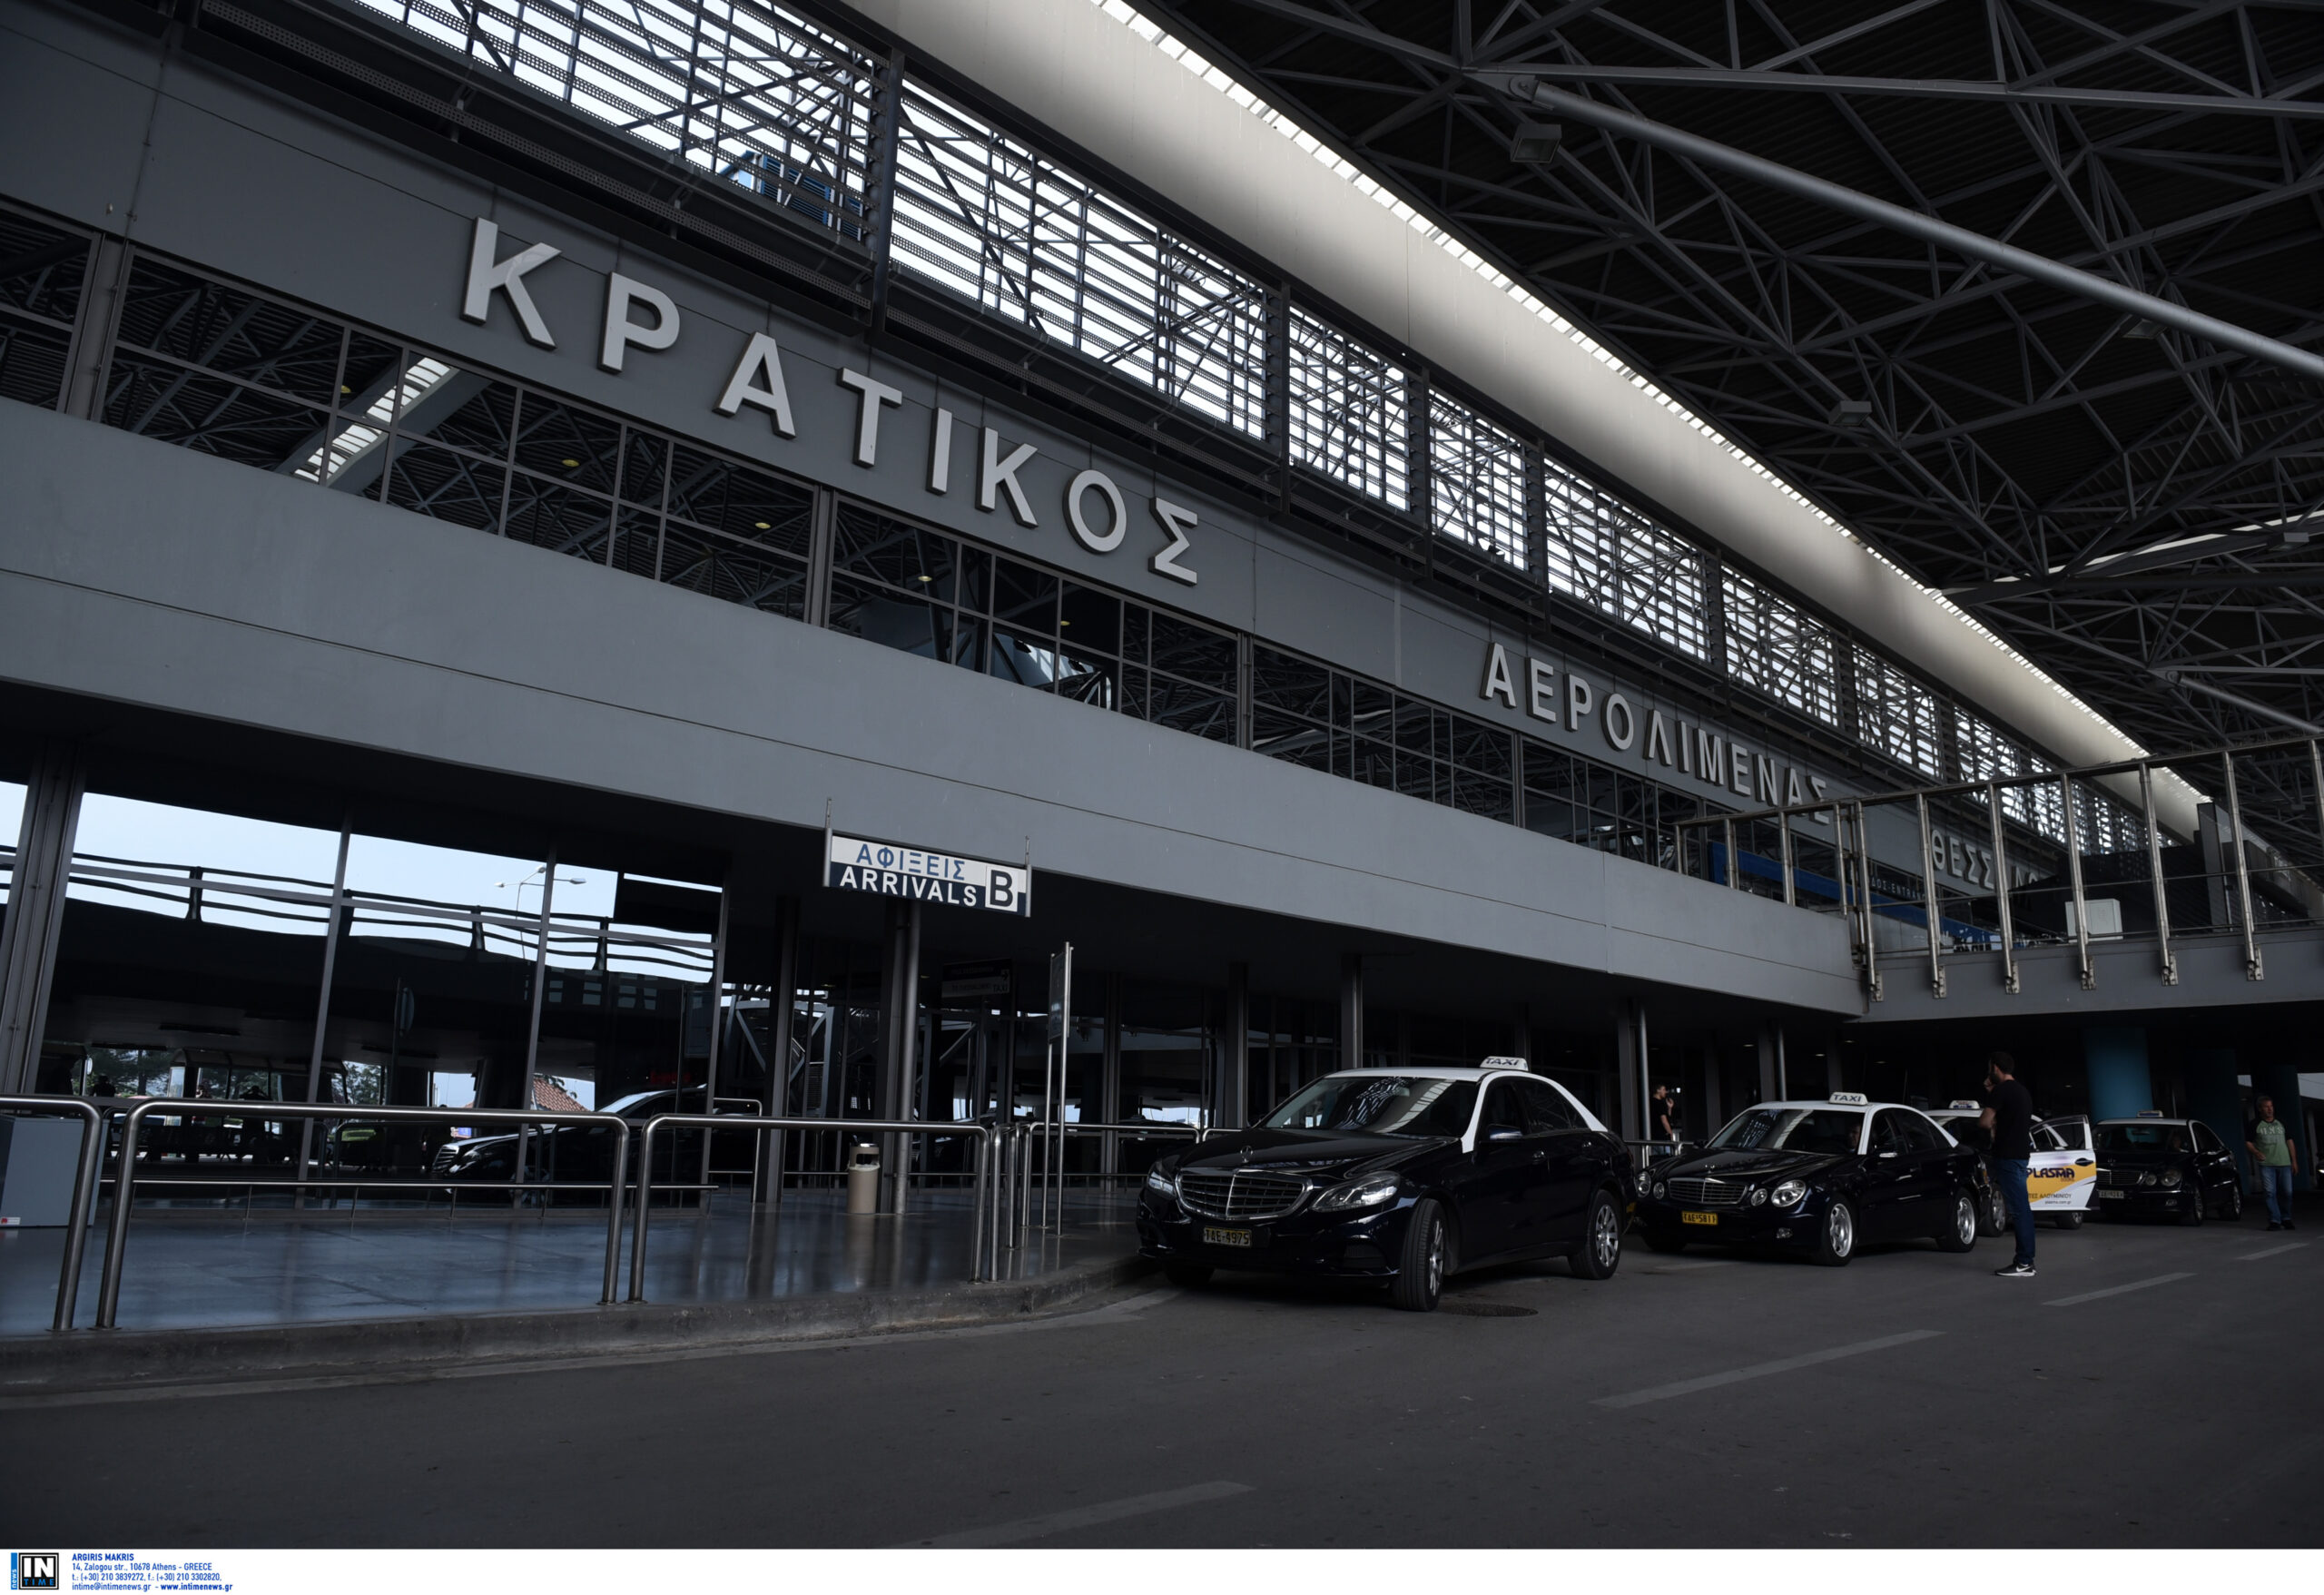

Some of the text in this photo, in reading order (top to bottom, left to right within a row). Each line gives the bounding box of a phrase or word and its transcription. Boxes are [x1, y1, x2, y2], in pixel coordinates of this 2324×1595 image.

[461, 216, 1198, 586] ΚΡΑΤΙΚΟΣ
[856, 843, 965, 881] ΑΦΙΞΕΙΣ
[840, 866, 1013, 907] ARRIVALS B
[1486, 1057, 1519, 1066] TAXI
[1833, 1094, 1862, 1102] TAXI
[2026, 1167, 2075, 1178] PLASMA
